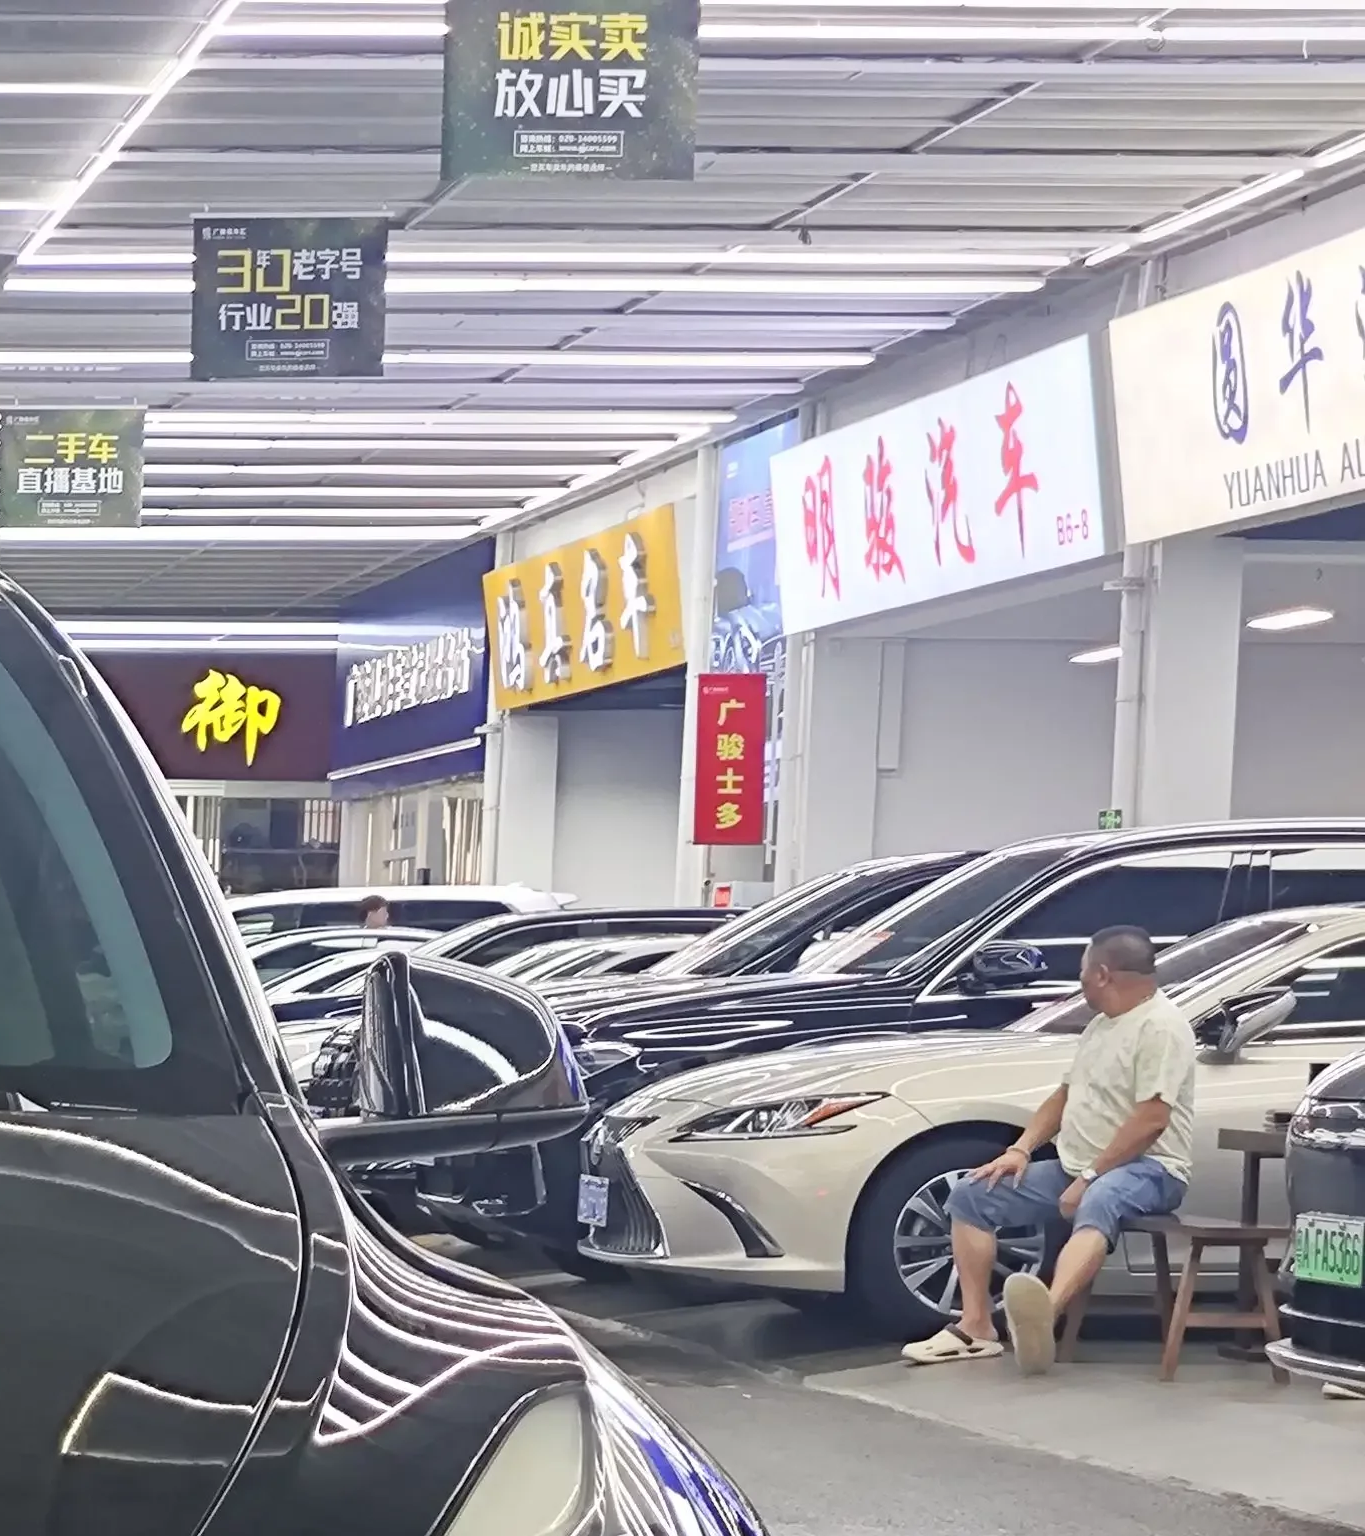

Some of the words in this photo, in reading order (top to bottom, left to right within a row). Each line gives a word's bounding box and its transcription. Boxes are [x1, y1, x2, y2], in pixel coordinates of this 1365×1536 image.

[497, 11, 648, 61] 诚实卖
[493, 67, 648, 118] 放心买
[216, 248, 363, 293] 30年老字号
[218, 293, 360, 331] 行业20强
[1212, 264, 1365, 444] 圆华
[24, 432, 119, 464] 二手车
[17, 467, 124, 495] 直播基地
[1223, 449, 1329, 509] YUANHUA
[1056, 508, 1089, 546] B6-8
[181, 668, 282, 768] 御
[715, 698, 746, 829] 广骏士多
